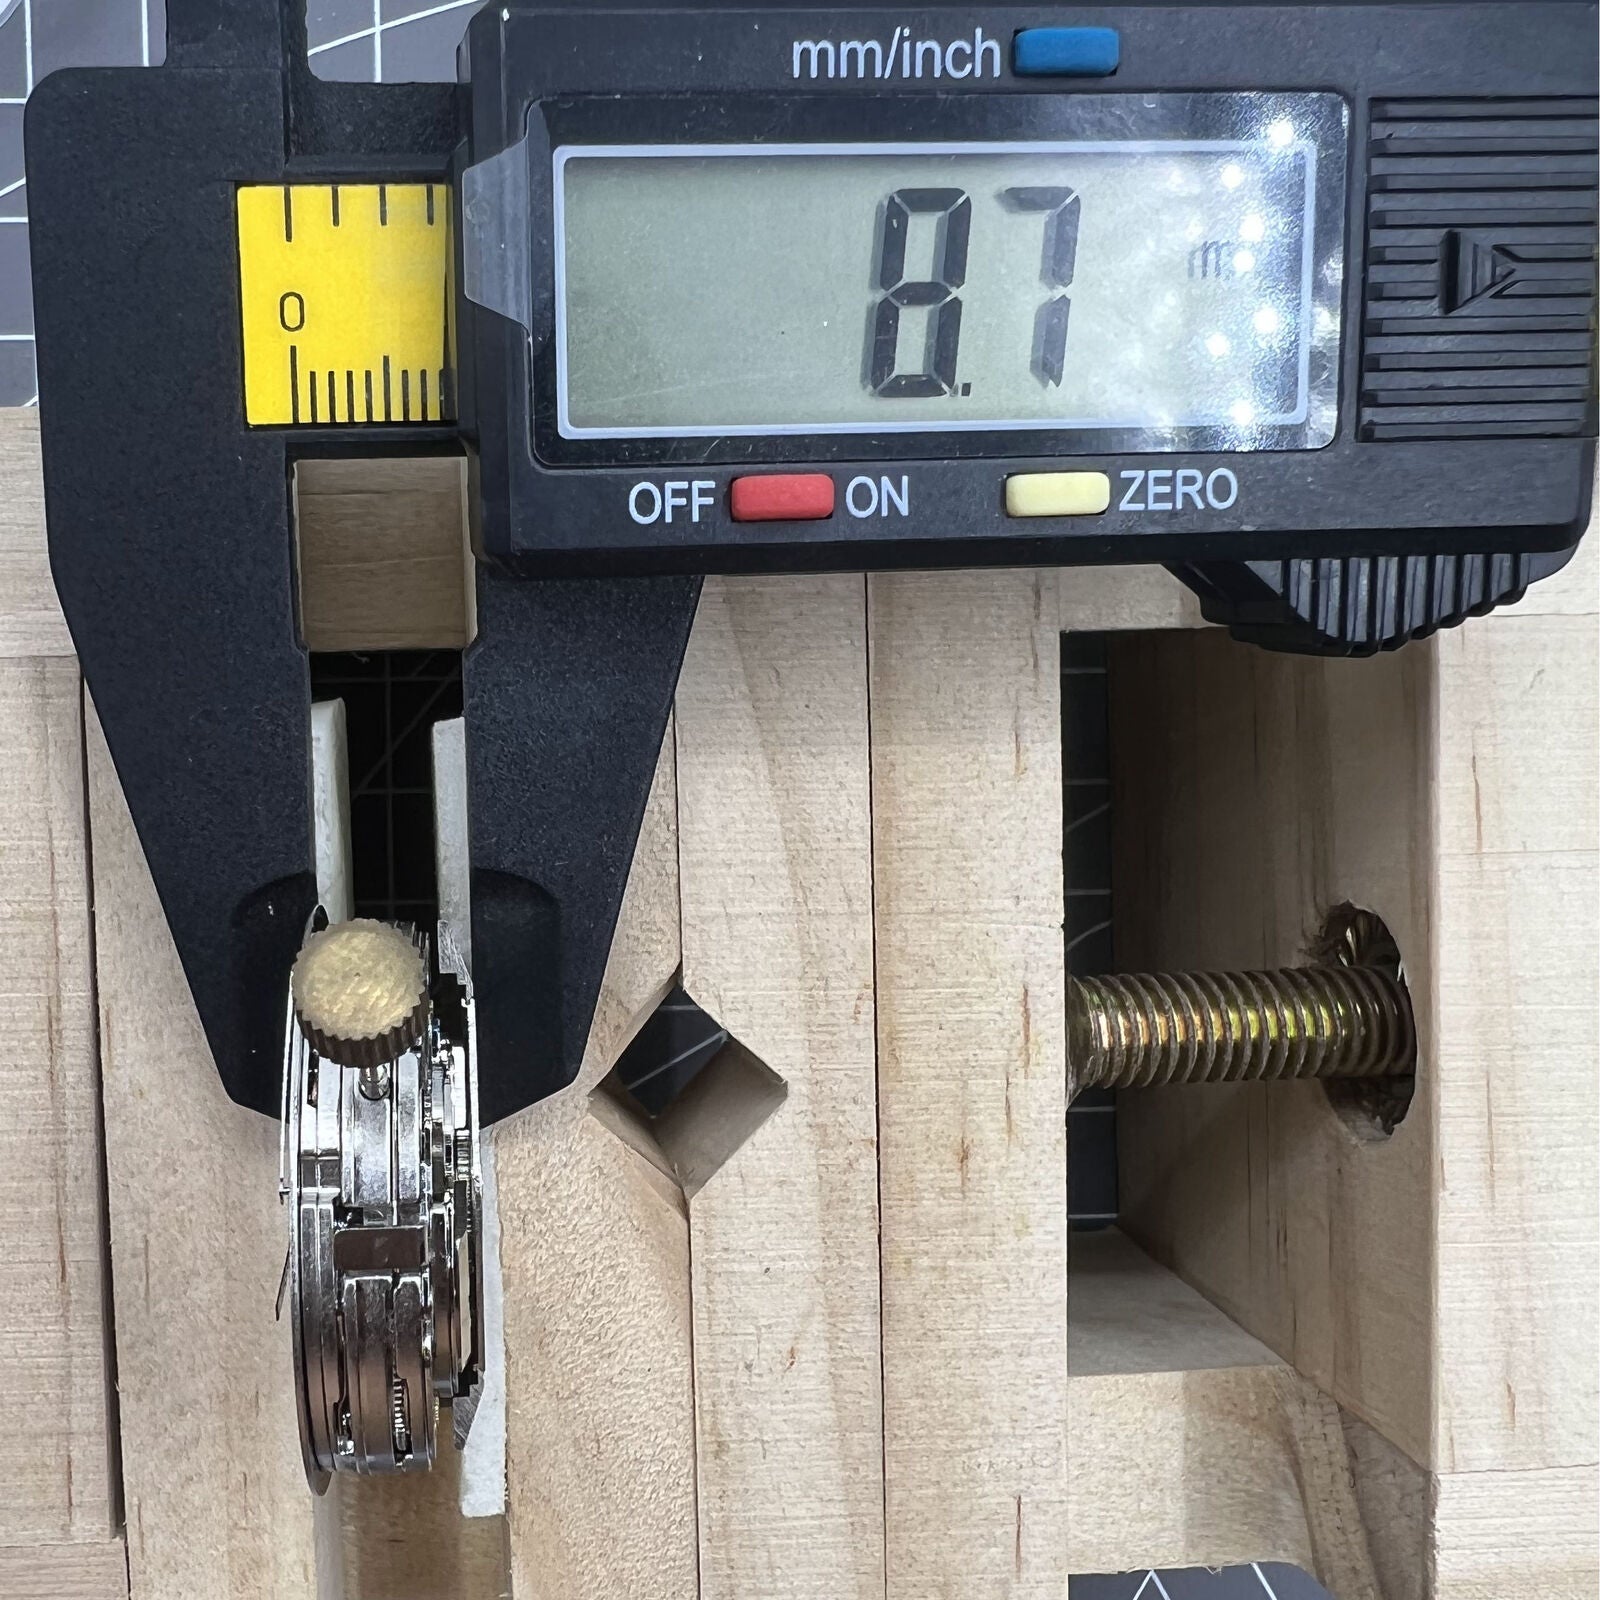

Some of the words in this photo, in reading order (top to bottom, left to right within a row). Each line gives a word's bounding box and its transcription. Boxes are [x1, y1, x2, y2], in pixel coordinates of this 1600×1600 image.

[792, 26, 1001, 79] mm/inch
[279, 291, 305, 332] 0
[866, 185, 1082, 398] 8.7
[628, 480, 716, 525] OFF
[845, 475, 909, 518] ON
[1118, 467, 1239, 511] ZERO
